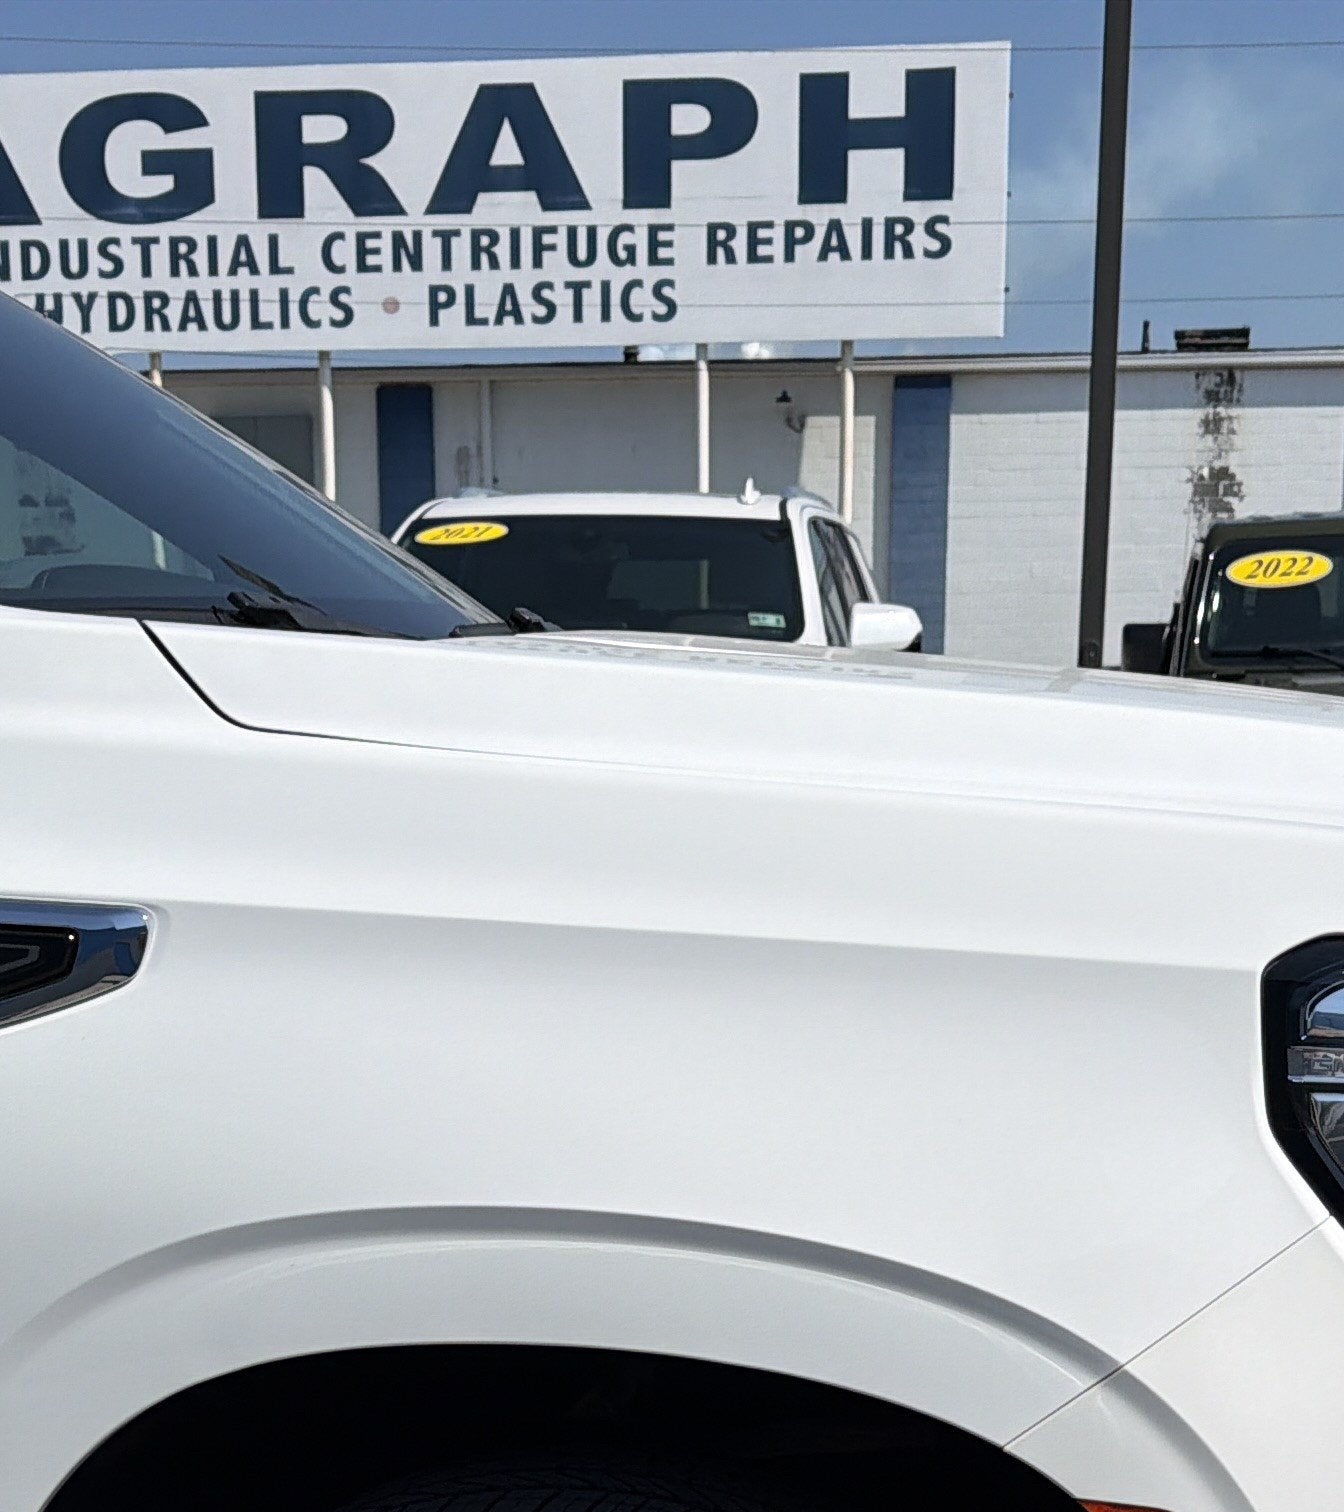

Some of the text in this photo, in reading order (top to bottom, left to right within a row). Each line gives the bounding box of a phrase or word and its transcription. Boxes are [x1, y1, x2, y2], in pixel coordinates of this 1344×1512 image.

[320, 224, 676, 275] CENTRIFUGE
[705, 214, 954, 267] REPAIRS
[34, 285, 355, 335] HYDRAULICS
[428, 278, 679, 328] PLASTICS
[430, 526, 493, 541] 2021
[1245, 556, 1313, 579] 2022
